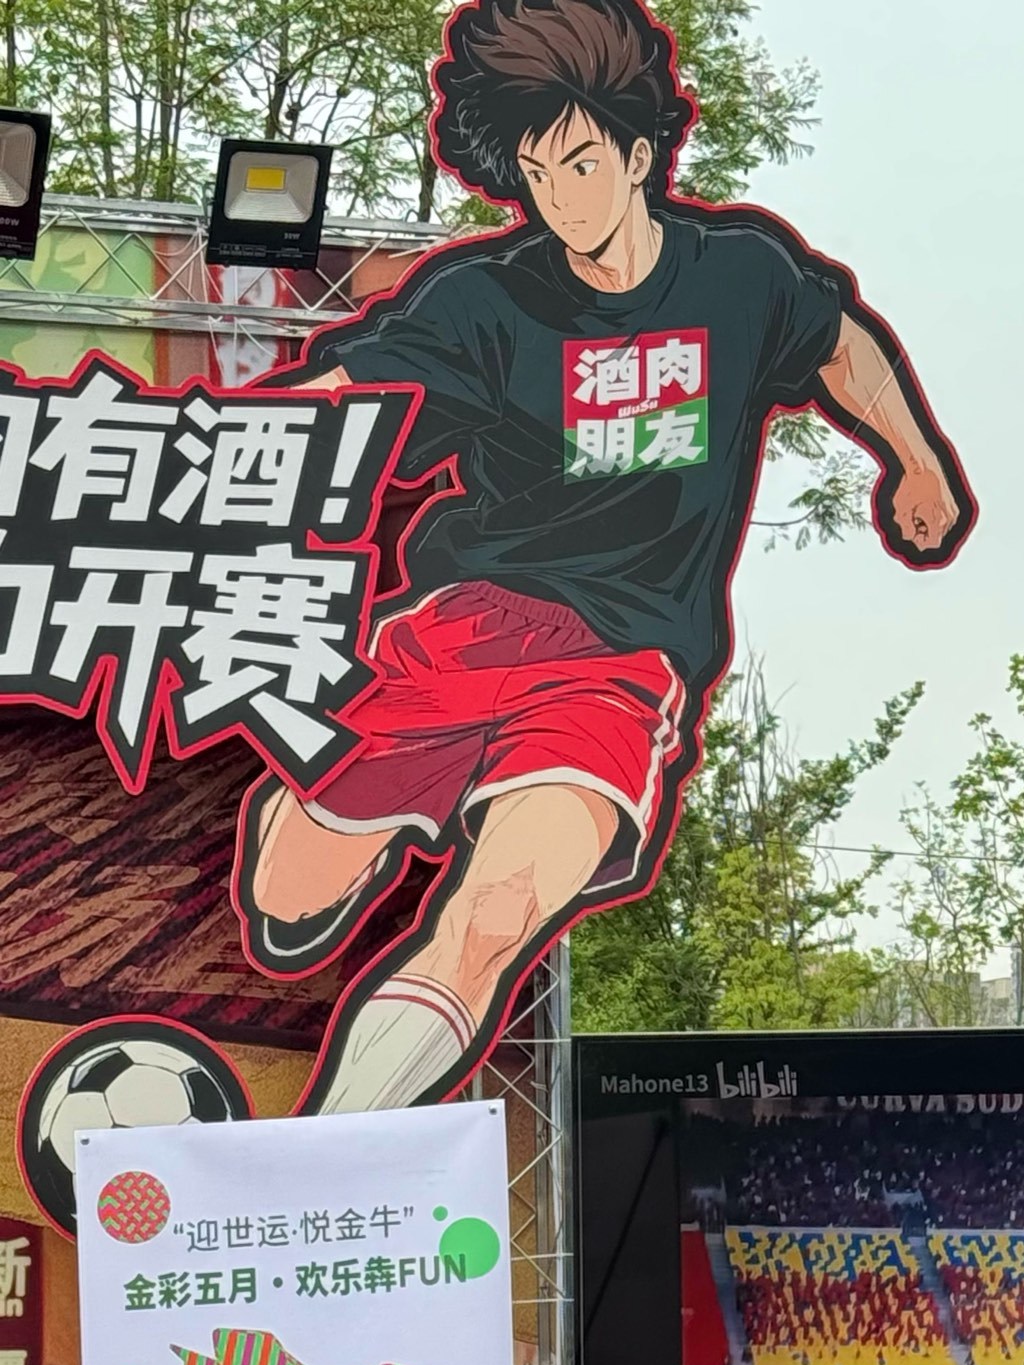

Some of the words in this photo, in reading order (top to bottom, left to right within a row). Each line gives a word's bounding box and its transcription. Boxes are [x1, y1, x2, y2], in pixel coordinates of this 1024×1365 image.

[572, 338, 702, 406] 酒肉
[618, 400, 659, 419] WuSu
[568, 410, 705, 477] 朋友
[601, 1073, 709, 1094] Mahone13
[715, 1060, 798, 1100] bilibili
